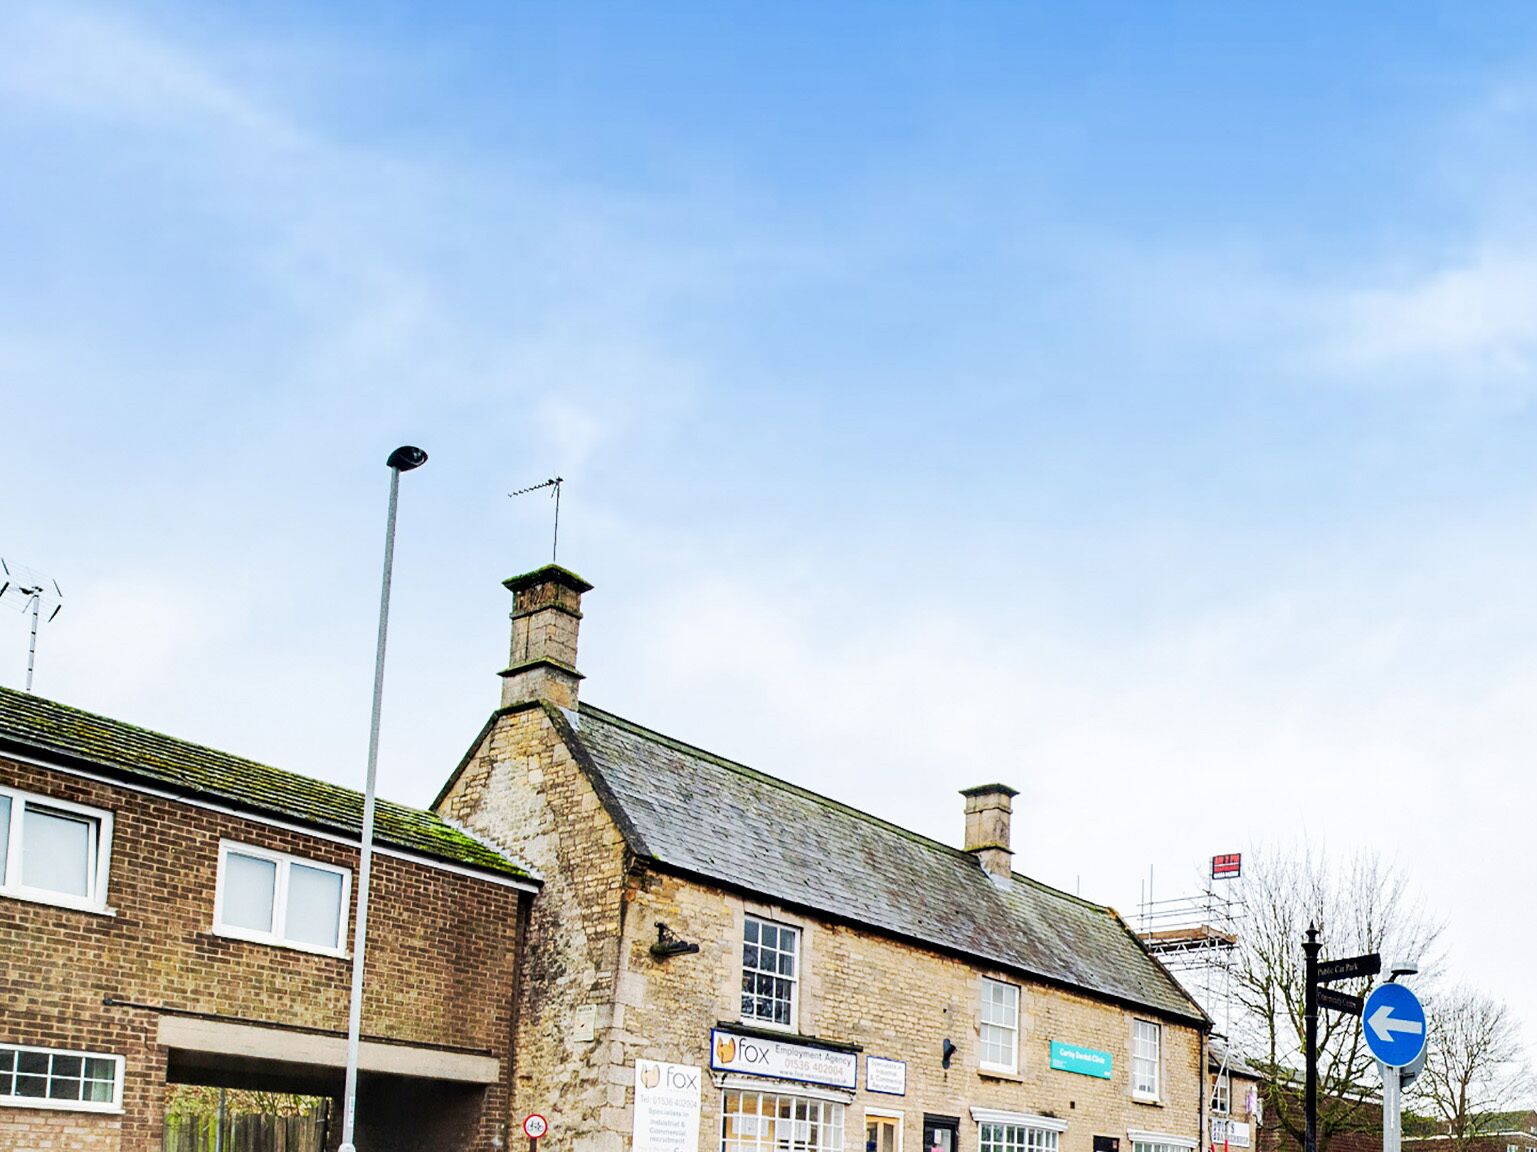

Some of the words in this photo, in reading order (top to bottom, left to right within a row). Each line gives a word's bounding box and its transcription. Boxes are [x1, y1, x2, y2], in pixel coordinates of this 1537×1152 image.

[1334, 964, 1344, 973] Car
[1345, 962, 1358, 972] Park
[739, 1037, 769, 1064] fox
[775, 1044, 822, 1060] Employment
[824, 1053, 851, 1067] Agency
[785, 1058, 810, 1071] 01536
[812, 1063, 844, 1075] 402004
[666, 1066, 697, 1090] fox
